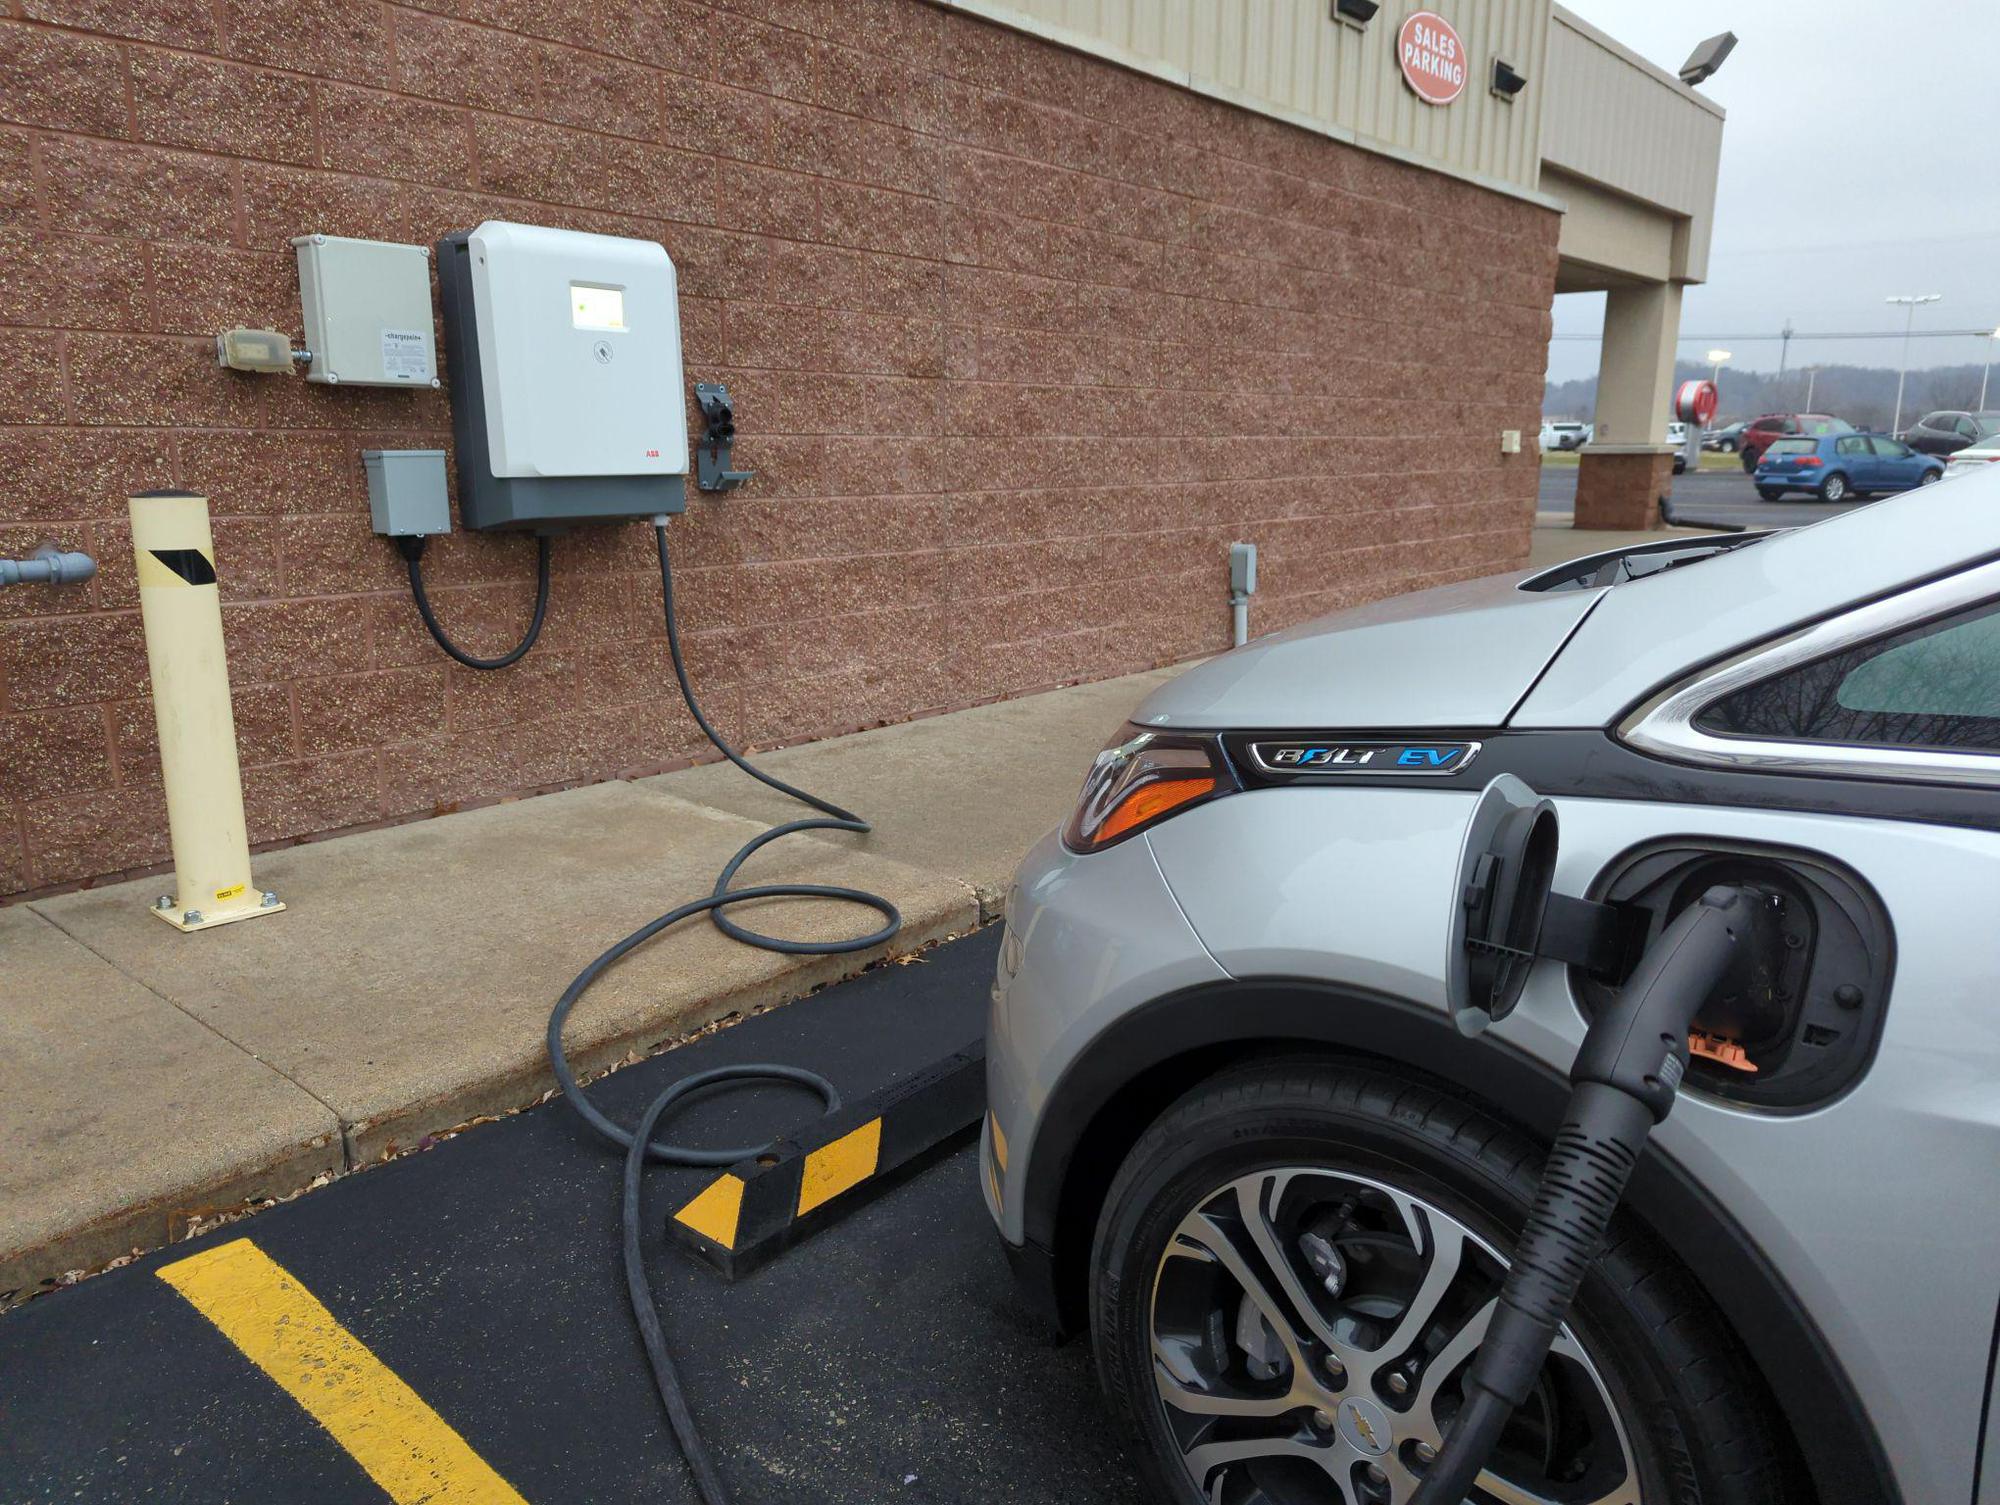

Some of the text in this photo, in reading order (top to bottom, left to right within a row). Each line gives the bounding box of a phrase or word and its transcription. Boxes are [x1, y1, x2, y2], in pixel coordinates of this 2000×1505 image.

[1415, 22, 1456, 59] SALES
[1404, 42, 1462, 86] PARKING
[1272, 747, 1460, 766] BOLT EV
